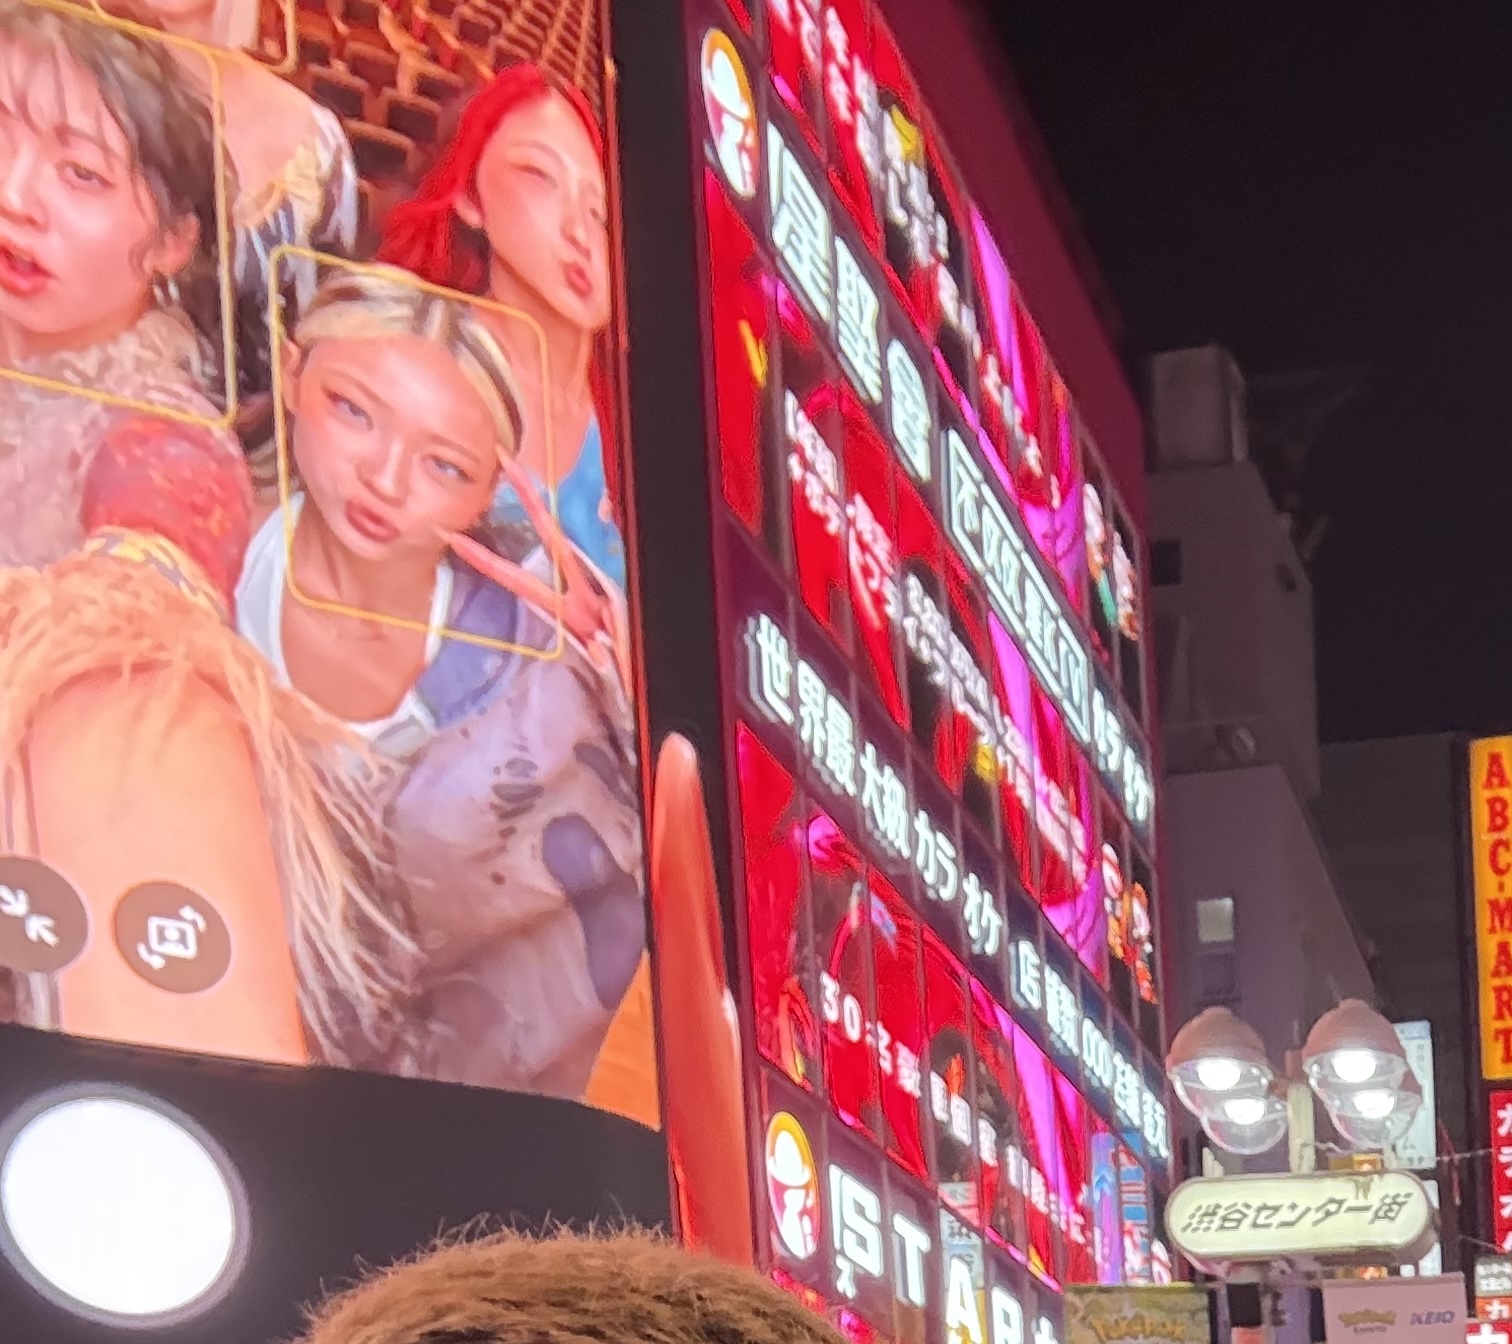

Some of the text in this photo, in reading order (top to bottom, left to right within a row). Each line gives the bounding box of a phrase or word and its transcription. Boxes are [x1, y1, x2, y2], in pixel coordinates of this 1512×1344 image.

[1180, 1192, 1413, 1234] 渋谷センター街
